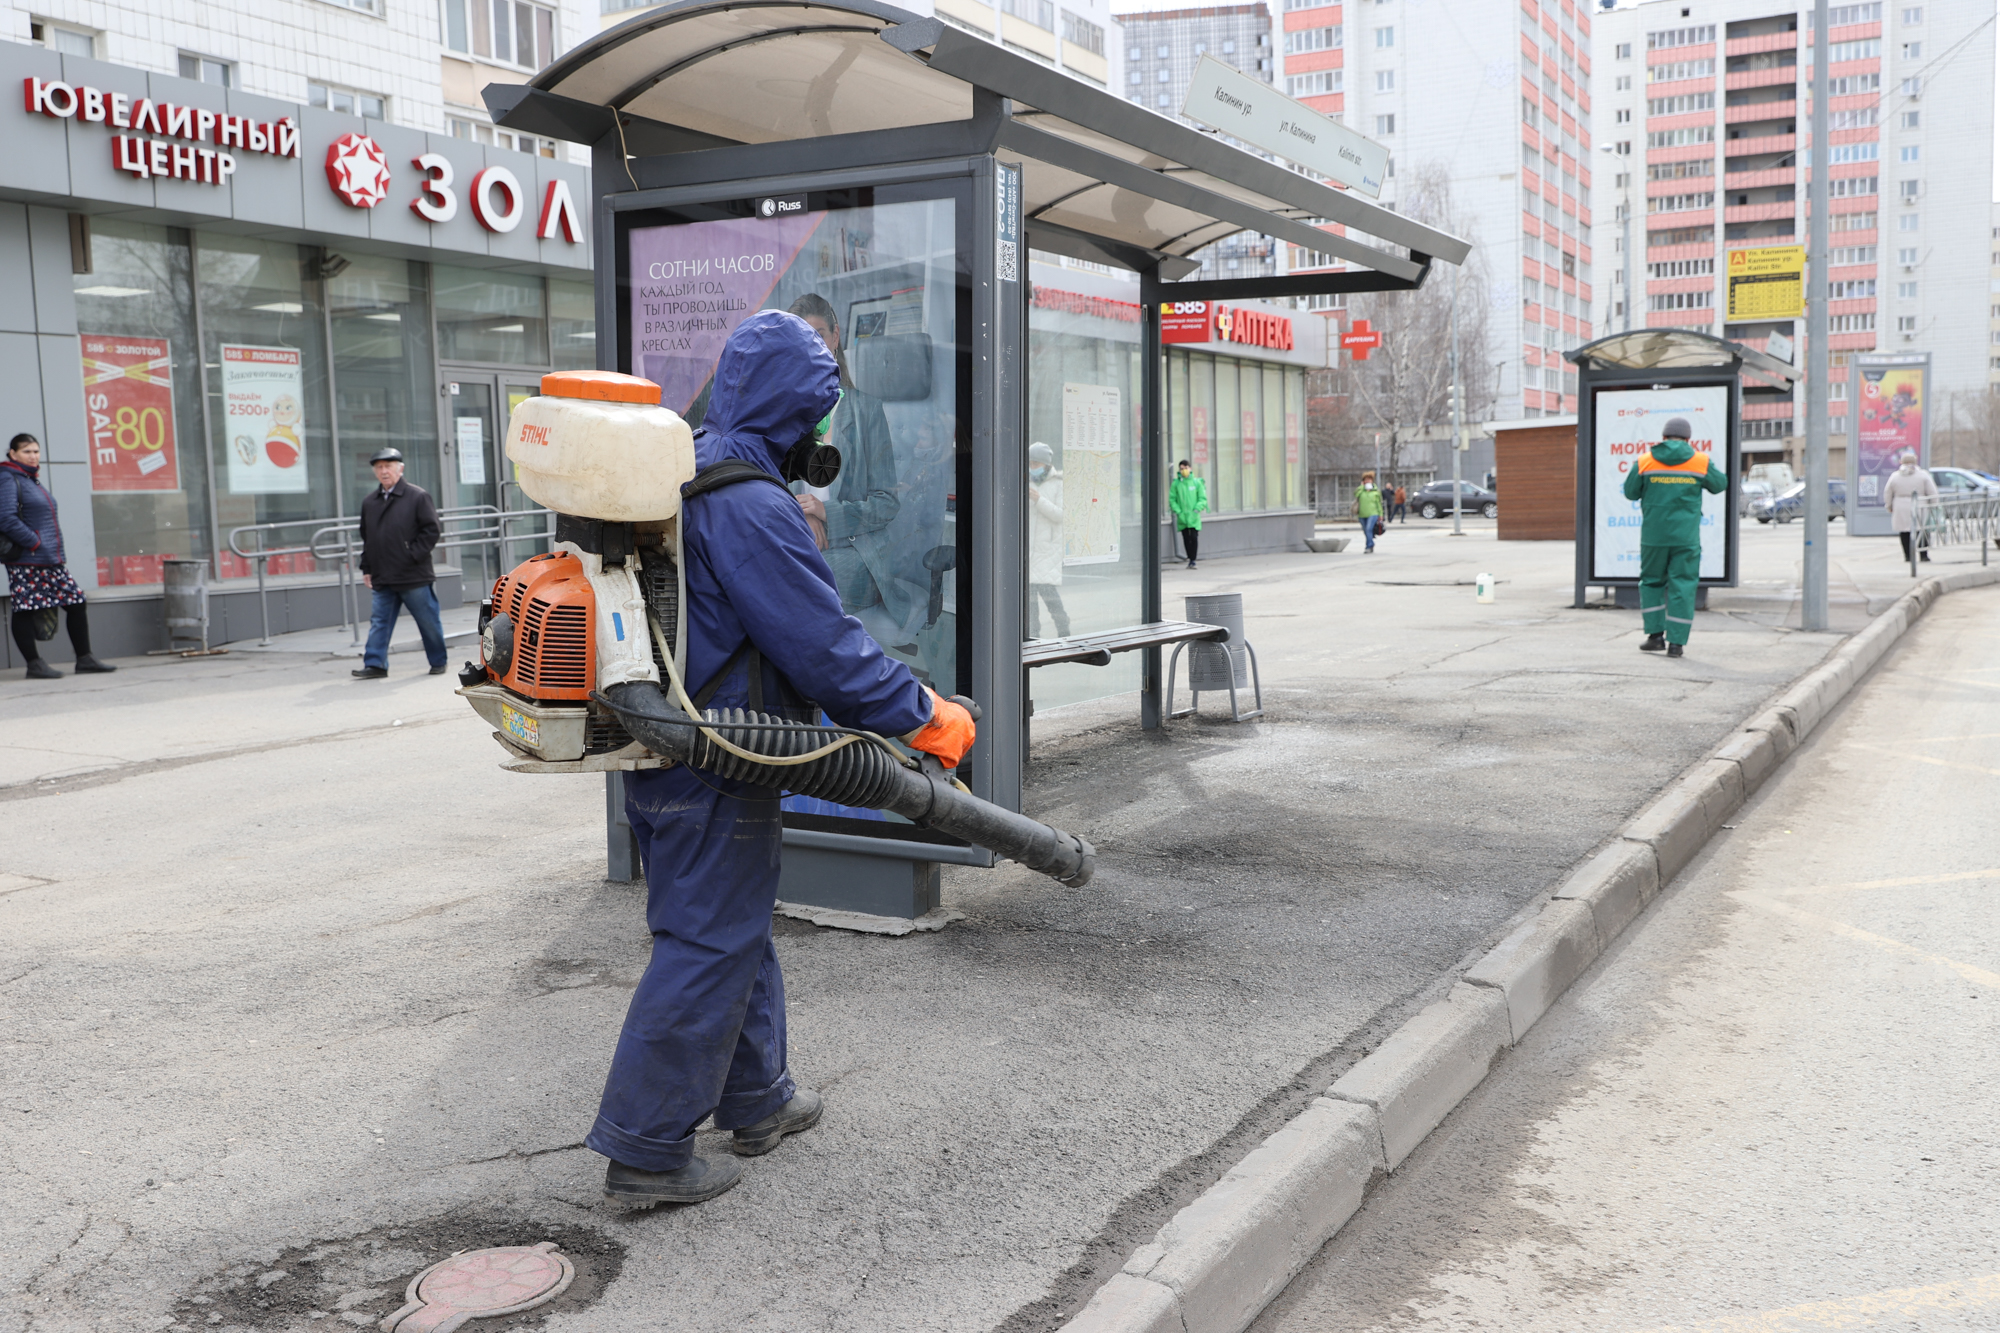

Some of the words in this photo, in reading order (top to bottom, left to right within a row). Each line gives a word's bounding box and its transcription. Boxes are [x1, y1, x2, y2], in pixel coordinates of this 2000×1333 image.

[1214, 86, 1243, 110] Калинин
[1242, 103, 1252, 116] ур.
[24, 76, 301, 159] ЮВЕЛИРНЫЙ
[1279, 120, 1289, 132] ул.
[1289, 122, 1316, 144] Калинина
[112, 134, 236, 186] ЦЕНТР
[1338, 145, 1354, 163] Kalinin
[778, 201, 801, 211] Russ
[997, 168, 1006, 233] ПЛО-2
[649, 259, 709, 280] СОТНИ
[715, 253, 775, 274] ЧАСОВ
[640, 281, 696, 298] КАЖДЫЙ
[699, 281, 725, 295] ГОД
[643, 303, 660, 316] ТЫ
[663, 298, 747, 315] ПРОВОДИШЬ
[1174, 301, 1206, 315] 585
[645, 321, 652, 334] В
[654, 317, 728, 333] РАЗЛИЧНЫХ
[1230, 308, 1294, 351] АПТЕКА
[86, 343, 104, 354] 585
[115, 345, 161, 356] ЗОЛОТОЙ
[642, 337, 692, 351] КРЕСЛАХ
[226, 349, 243, 359] 585
[251, 351, 297, 364] ЛОМБАРД
[89, 393, 117, 465] SALE
[520, 424, 549, 446] STIHL
